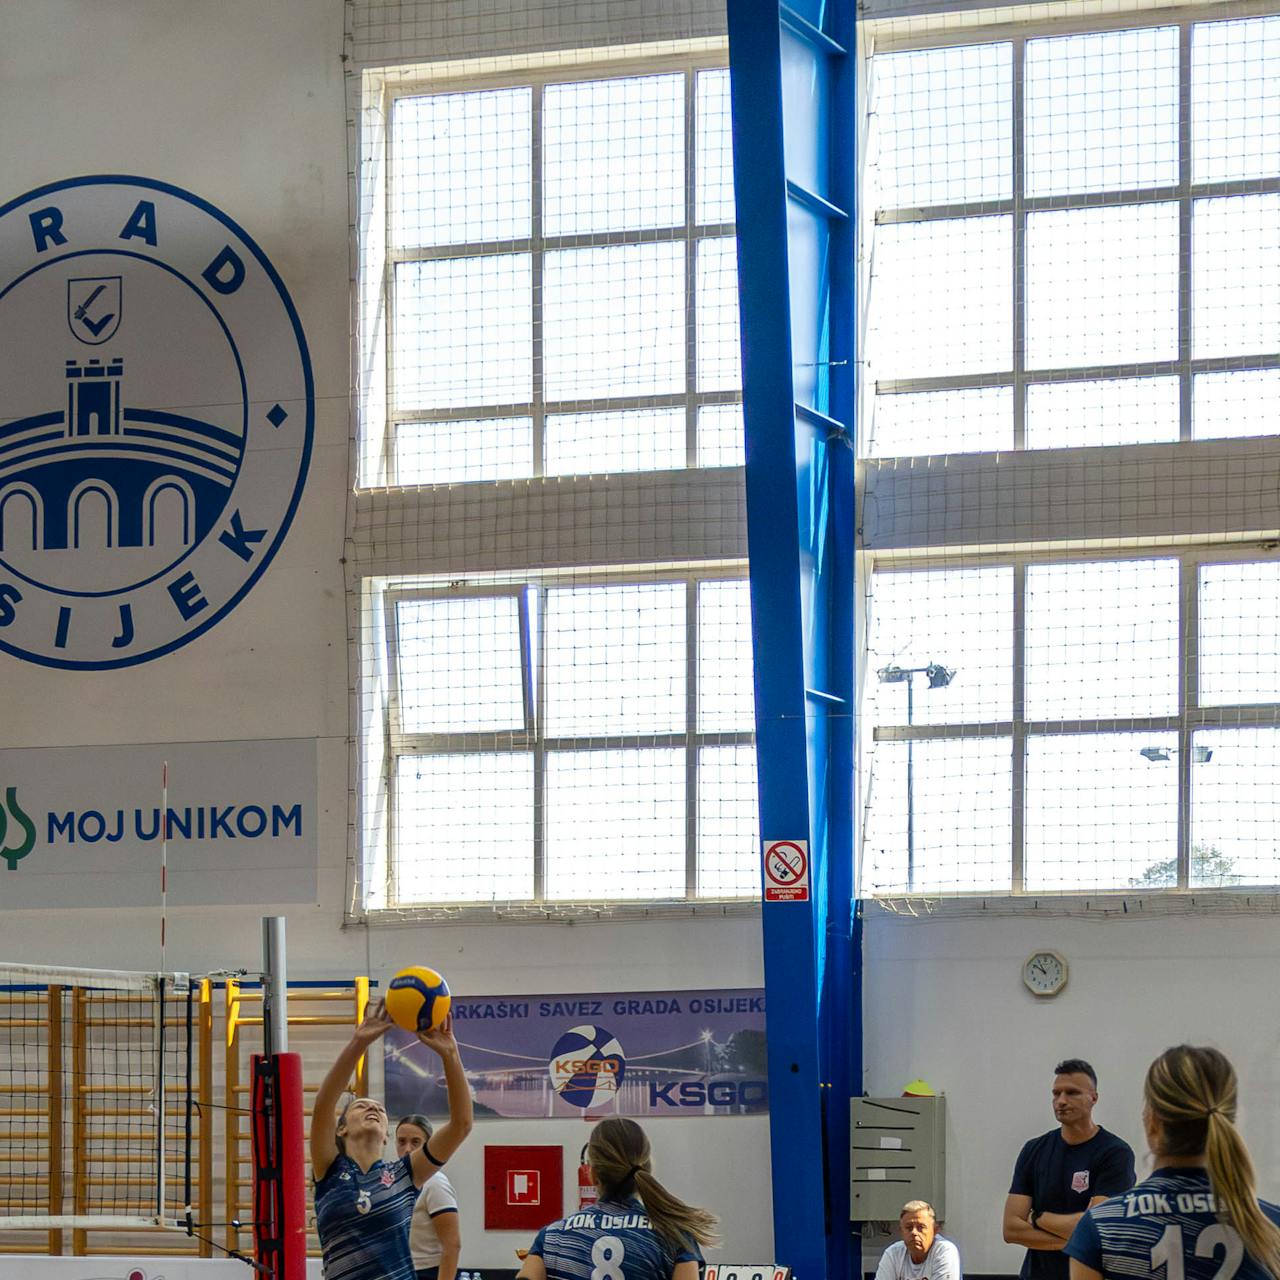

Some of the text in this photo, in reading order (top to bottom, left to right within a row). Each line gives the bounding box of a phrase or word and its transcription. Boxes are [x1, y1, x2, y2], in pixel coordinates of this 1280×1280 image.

[47, 804, 303, 844] MOJ UNIKOM
[451, 997, 767, 1020] RKAŠKI SAVEZ GRADA OSIJEK
[556, 1059, 619, 1075] KSGO
[650, 1082, 768, 1107] KSGO
[356, 1189, 372, 1215] 5
[1176, 1193, 1222, 1214] OSI
